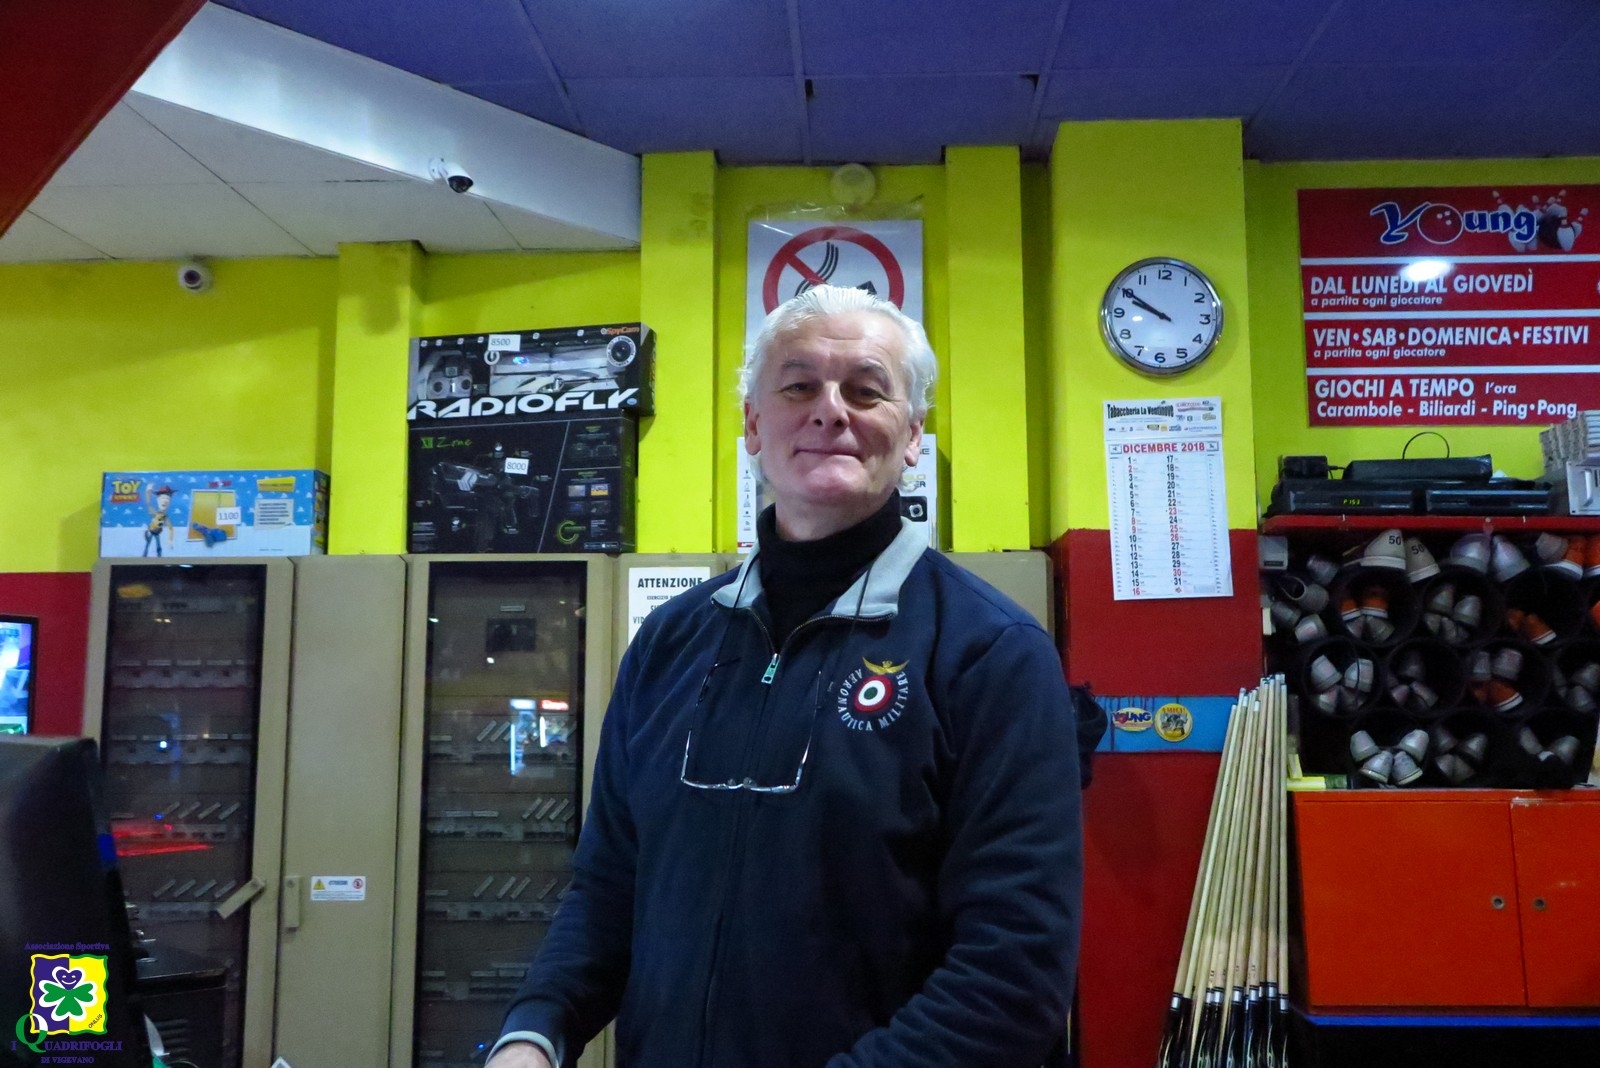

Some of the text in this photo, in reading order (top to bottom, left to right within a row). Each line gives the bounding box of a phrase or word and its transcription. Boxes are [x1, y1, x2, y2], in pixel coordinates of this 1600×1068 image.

[1158, 269, 1173, 280] 12
[1138, 275, 1147, 286] 11
[1310, 276, 1346, 295] DAL
[1424, 274, 1447, 294] AL
[1453, 267, 1534, 294] GIOVEDÌ
[1122, 287, 1134, 298] 10
[1194, 292, 1206, 304] 2
[1310, 295, 1444, 308] a partita ogni giocatore
[1113, 307, 1126, 318] 9
[1199, 313, 1211, 325] 3
[1120, 328, 1132, 340] 8
[1192, 333, 1203, 344] 4
[490, 338, 511, 346] 8500
[1134, 345, 1144, 356] 7
[1176, 348, 1188, 359] 5
[1313, 347, 1447, 360] a partita ogni giocatore
[1154, 352, 1166, 364] 6
[1314, 379, 1385, 399] GIOCHI
[1389, 378, 1405, 398] A
[1409, 378, 1475, 398] TEMPO
[406, 388, 639, 420] RADIOFLY
[1316, 400, 1403, 418] Carambole
[1419, 400, 1476, 417] Biliardi
[1140, 406, 1147, 415] La
[1123, 442, 1205, 454] DICEMBRE 2018
[1166, 455, 1174, 463] 17
[506, 461, 527, 471] 8000
[1167, 463, 1174, 471] 18
[1167, 472, 1175, 480] 19
[1167, 481, 1176, 489] 20
[1168, 490, 1175, 498] 21
[1168, 498, 1177, 507] 22
[217, 511, 240, 521] 1100
[1169, 507, 1177, 515] 23
[1169, 516, 1178, 524] 24
[1170, 524, 1178, 533] 25
[1129, 534, 1137, 543] 10
[1170, 533, 1179, 541] 26
[1389, 535, 1402, 546] 50
[1130, 543, 1137, 551] 11
[1171, 542, 1180, 550] 27
[1411, 543, 1425, 555] 50
[1130, 552, 1138, 560] 12
[1171, 551, 1180, 559] 28
[1131, 561, 1139, 569] 13
[1172, 559, 1181, 568] 29
[1173, 568, 1182, 577] 30
[637, 577, 703, 588] ATTENZIONE
[1174, 577, 1182, 585] 31
[1132, 588, 1141, 596] 16
[838, 668, 873, 731] AERONAUTICA
[878, 671, 909, 729] MILITARE
